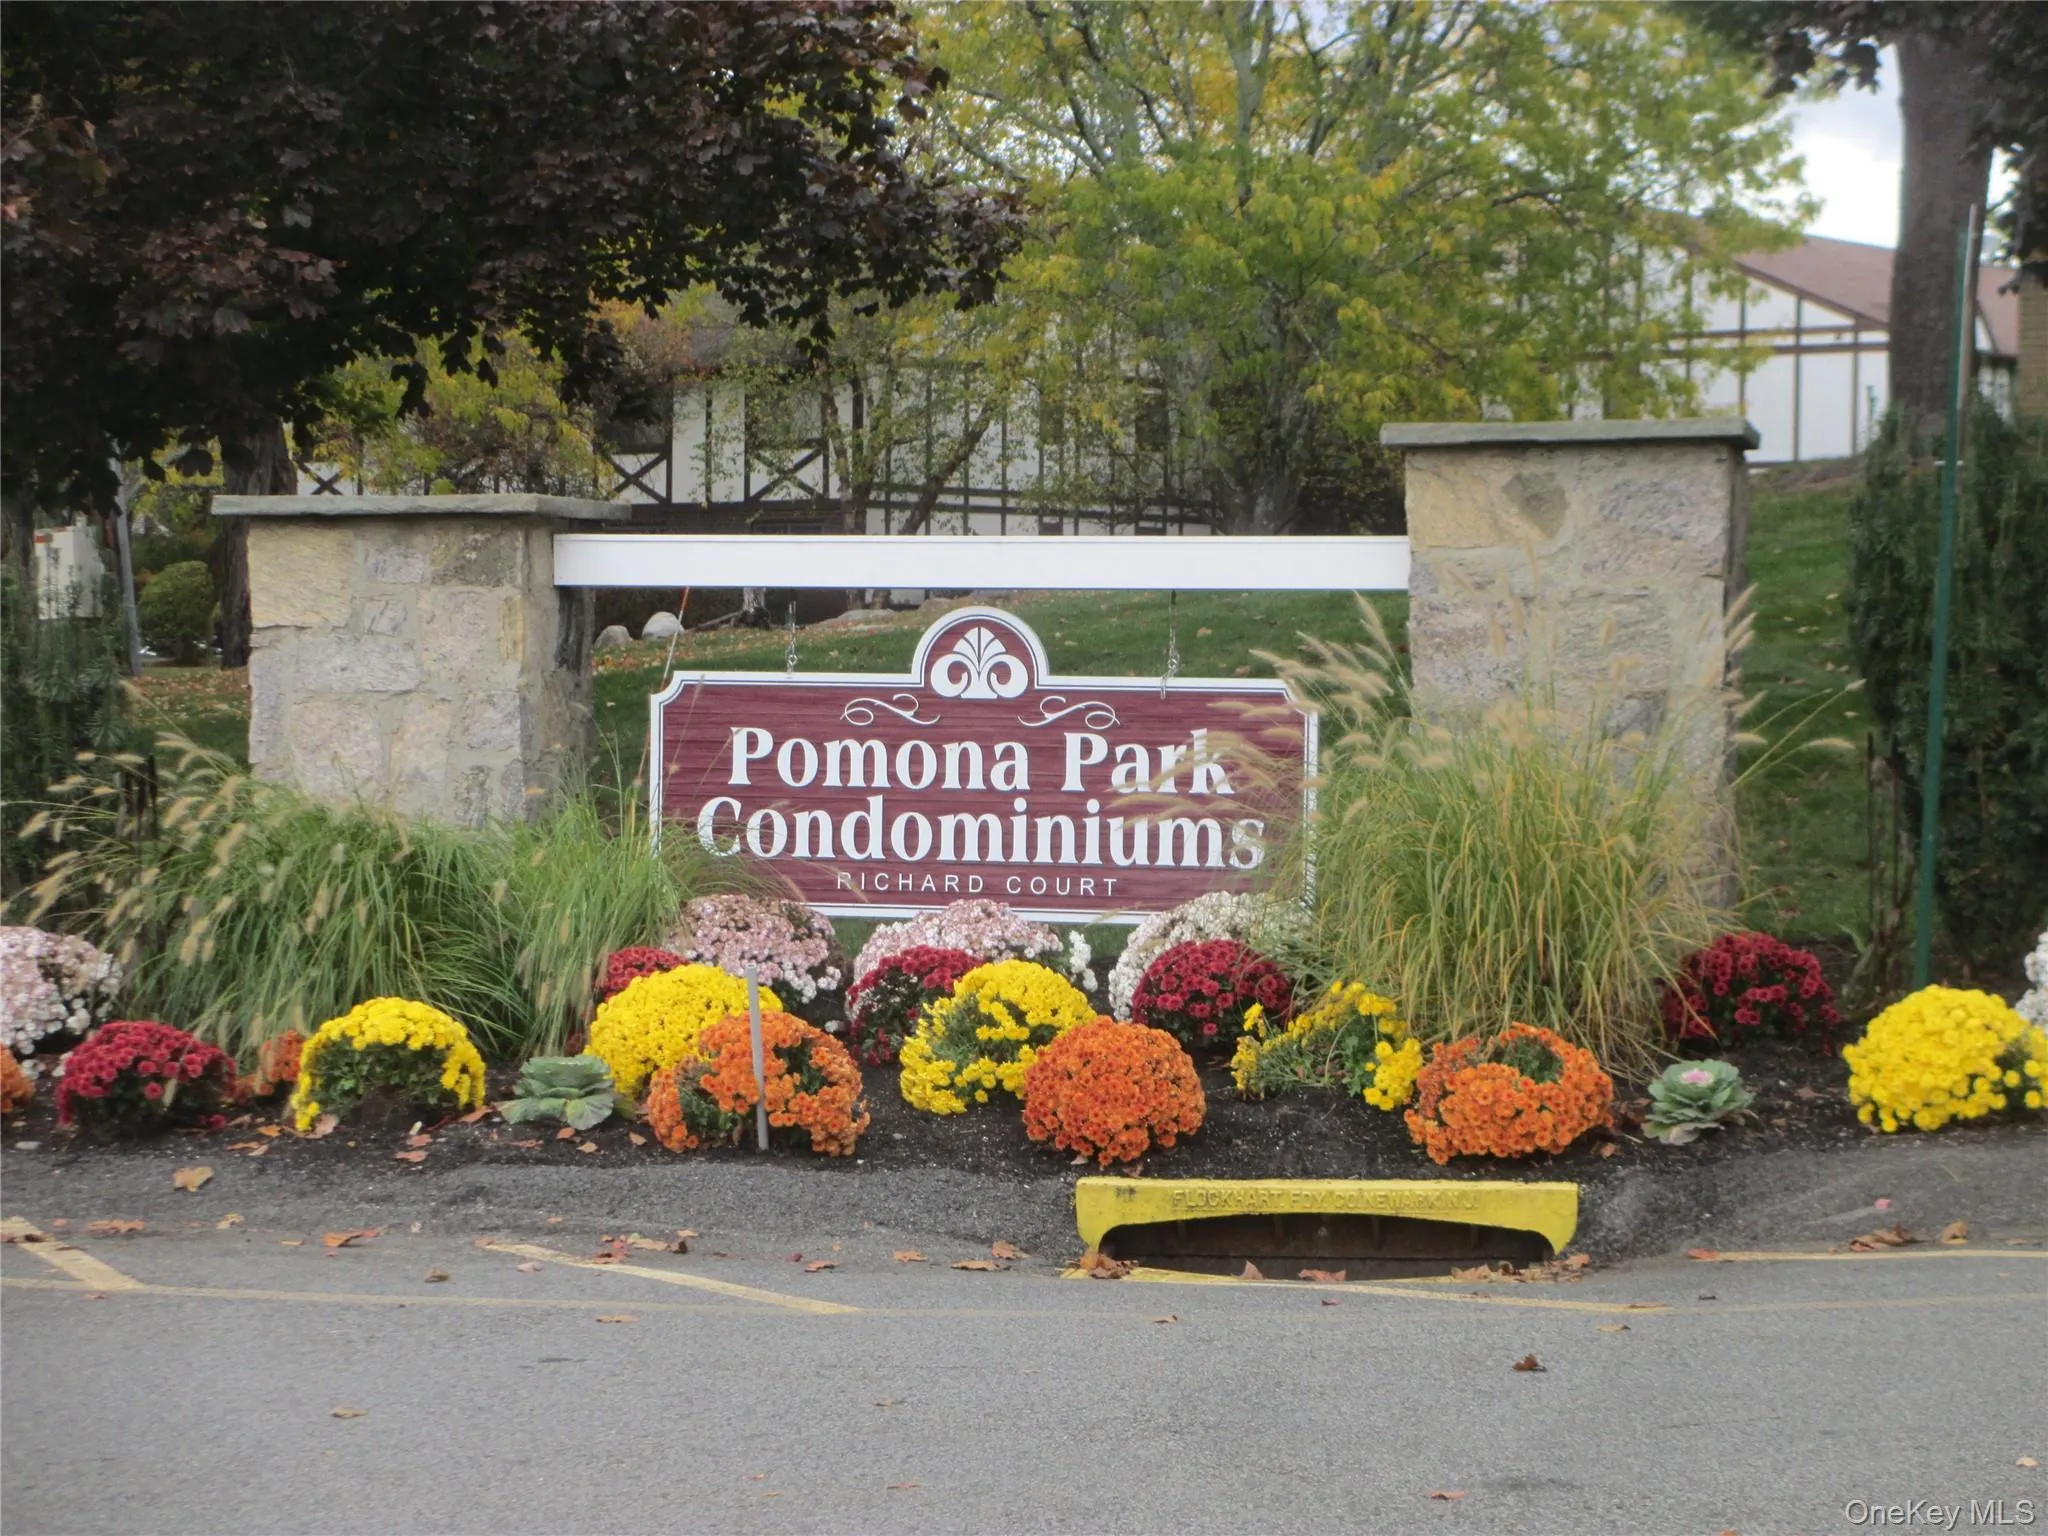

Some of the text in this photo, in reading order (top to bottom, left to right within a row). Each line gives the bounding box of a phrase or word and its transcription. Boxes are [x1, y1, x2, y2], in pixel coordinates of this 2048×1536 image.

[728, 727, 1235, 794] Pomona Park
[697, 794, 1265, 869] Condominiums
[837, 872, 1117, 896] RICHARD COURT
